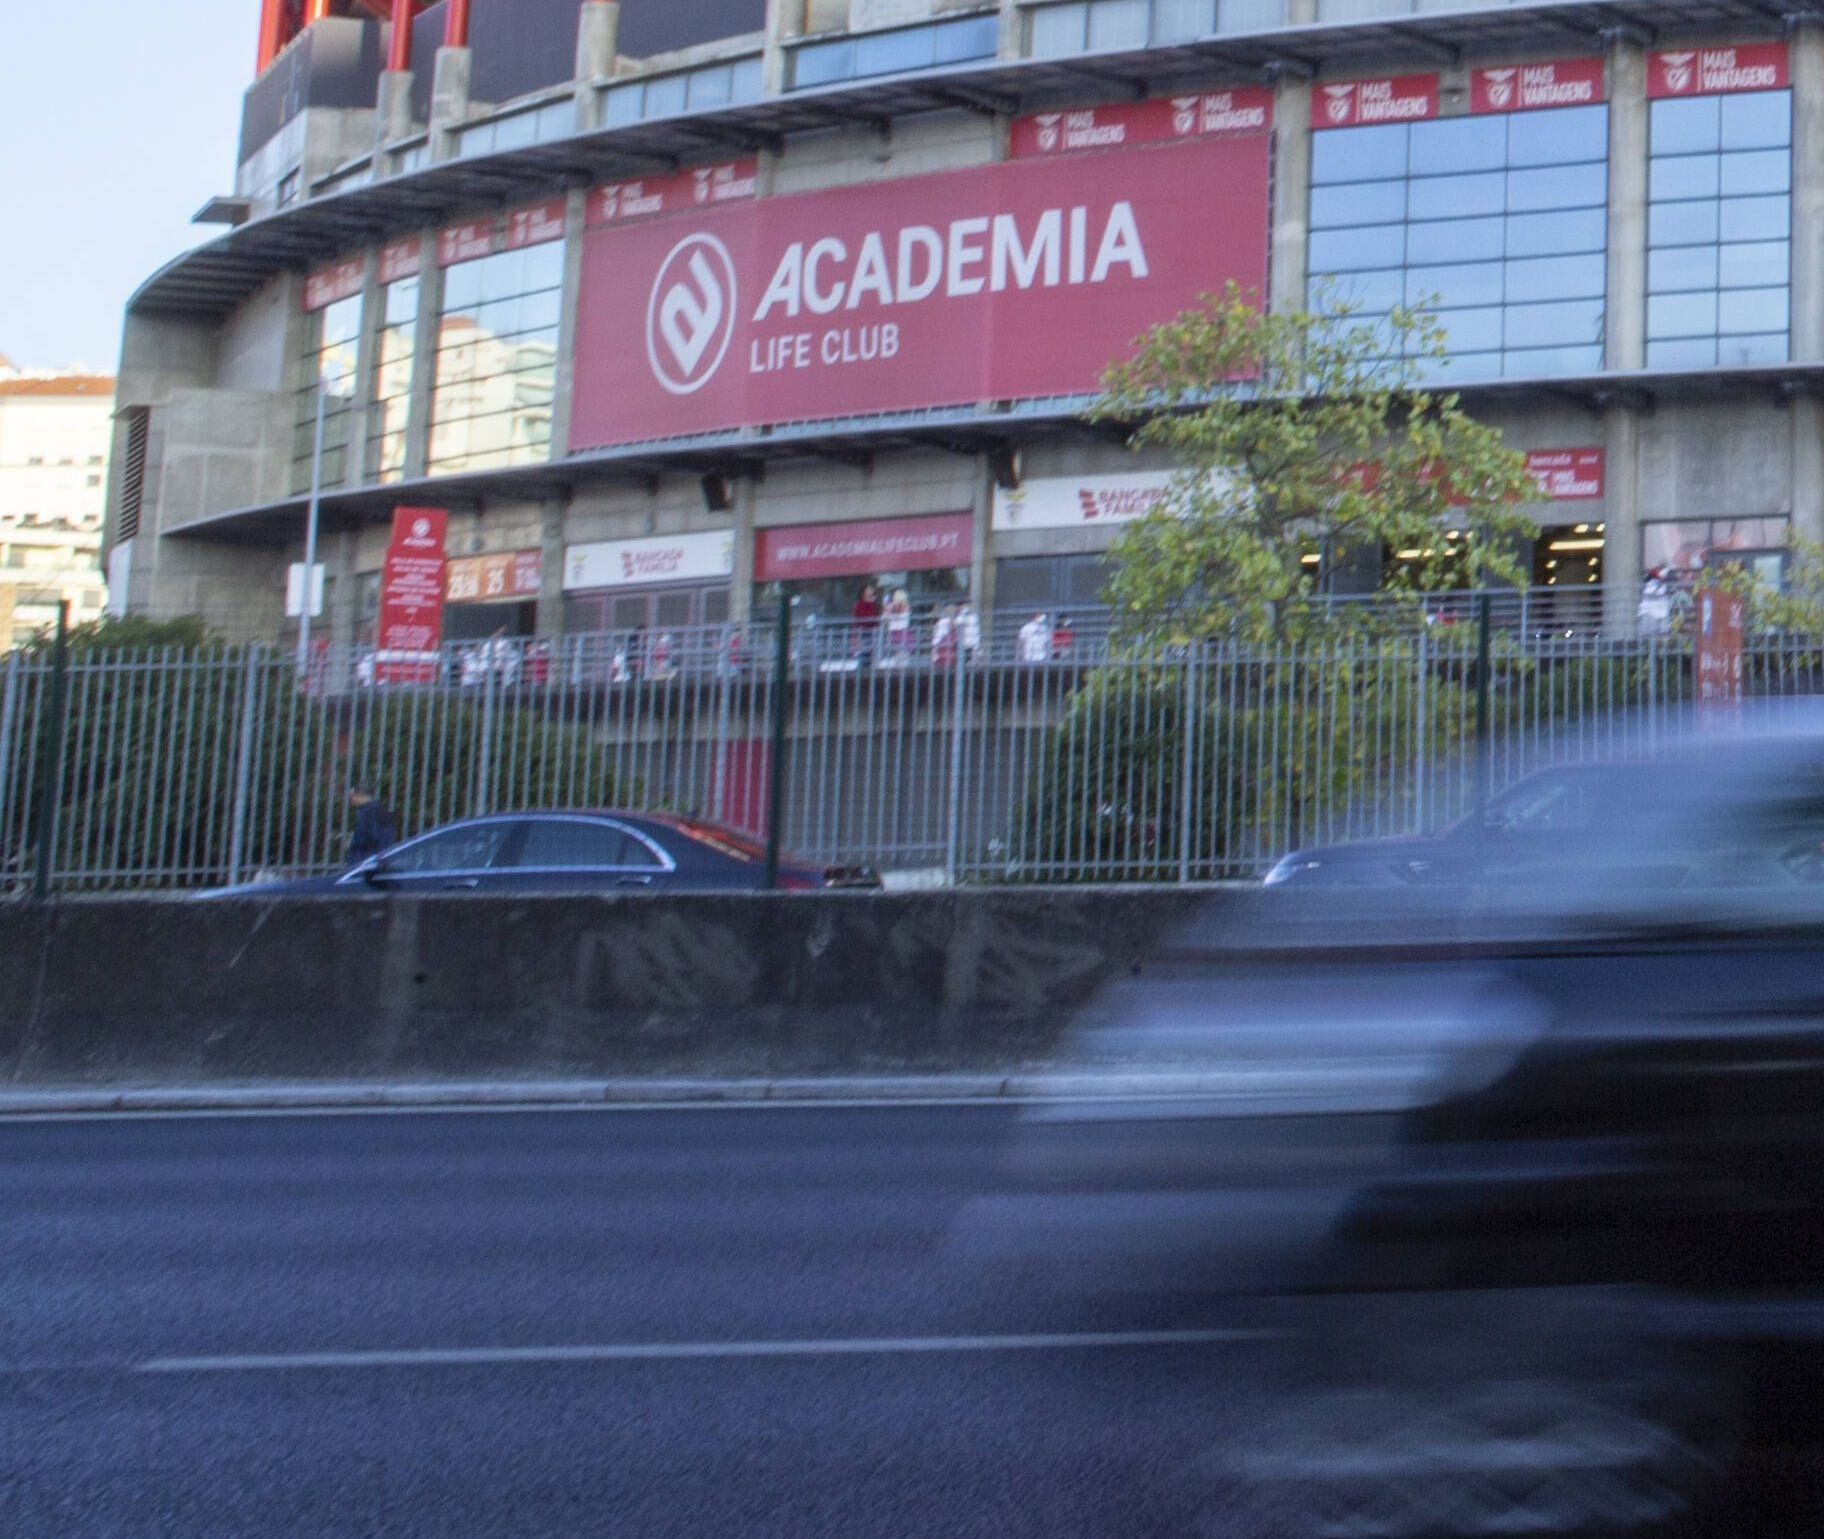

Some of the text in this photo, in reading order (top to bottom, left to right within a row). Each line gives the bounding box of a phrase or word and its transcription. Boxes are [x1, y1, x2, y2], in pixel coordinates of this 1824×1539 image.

[1703, 49, 1736, 68] MAIS
[1523, 65, 1554, 84] MAIS
[1703, 65, 1776, 90] VANTAGENS
[1522, 80, 1592, 106] VANTAGENS
[752, 201, 1149, 322] ACADEMIA
[749, 323, 899, 373] LIFE CLUB
[777, 533, 959, 561] WWW.ACADEMIALIFECLUB.PT
